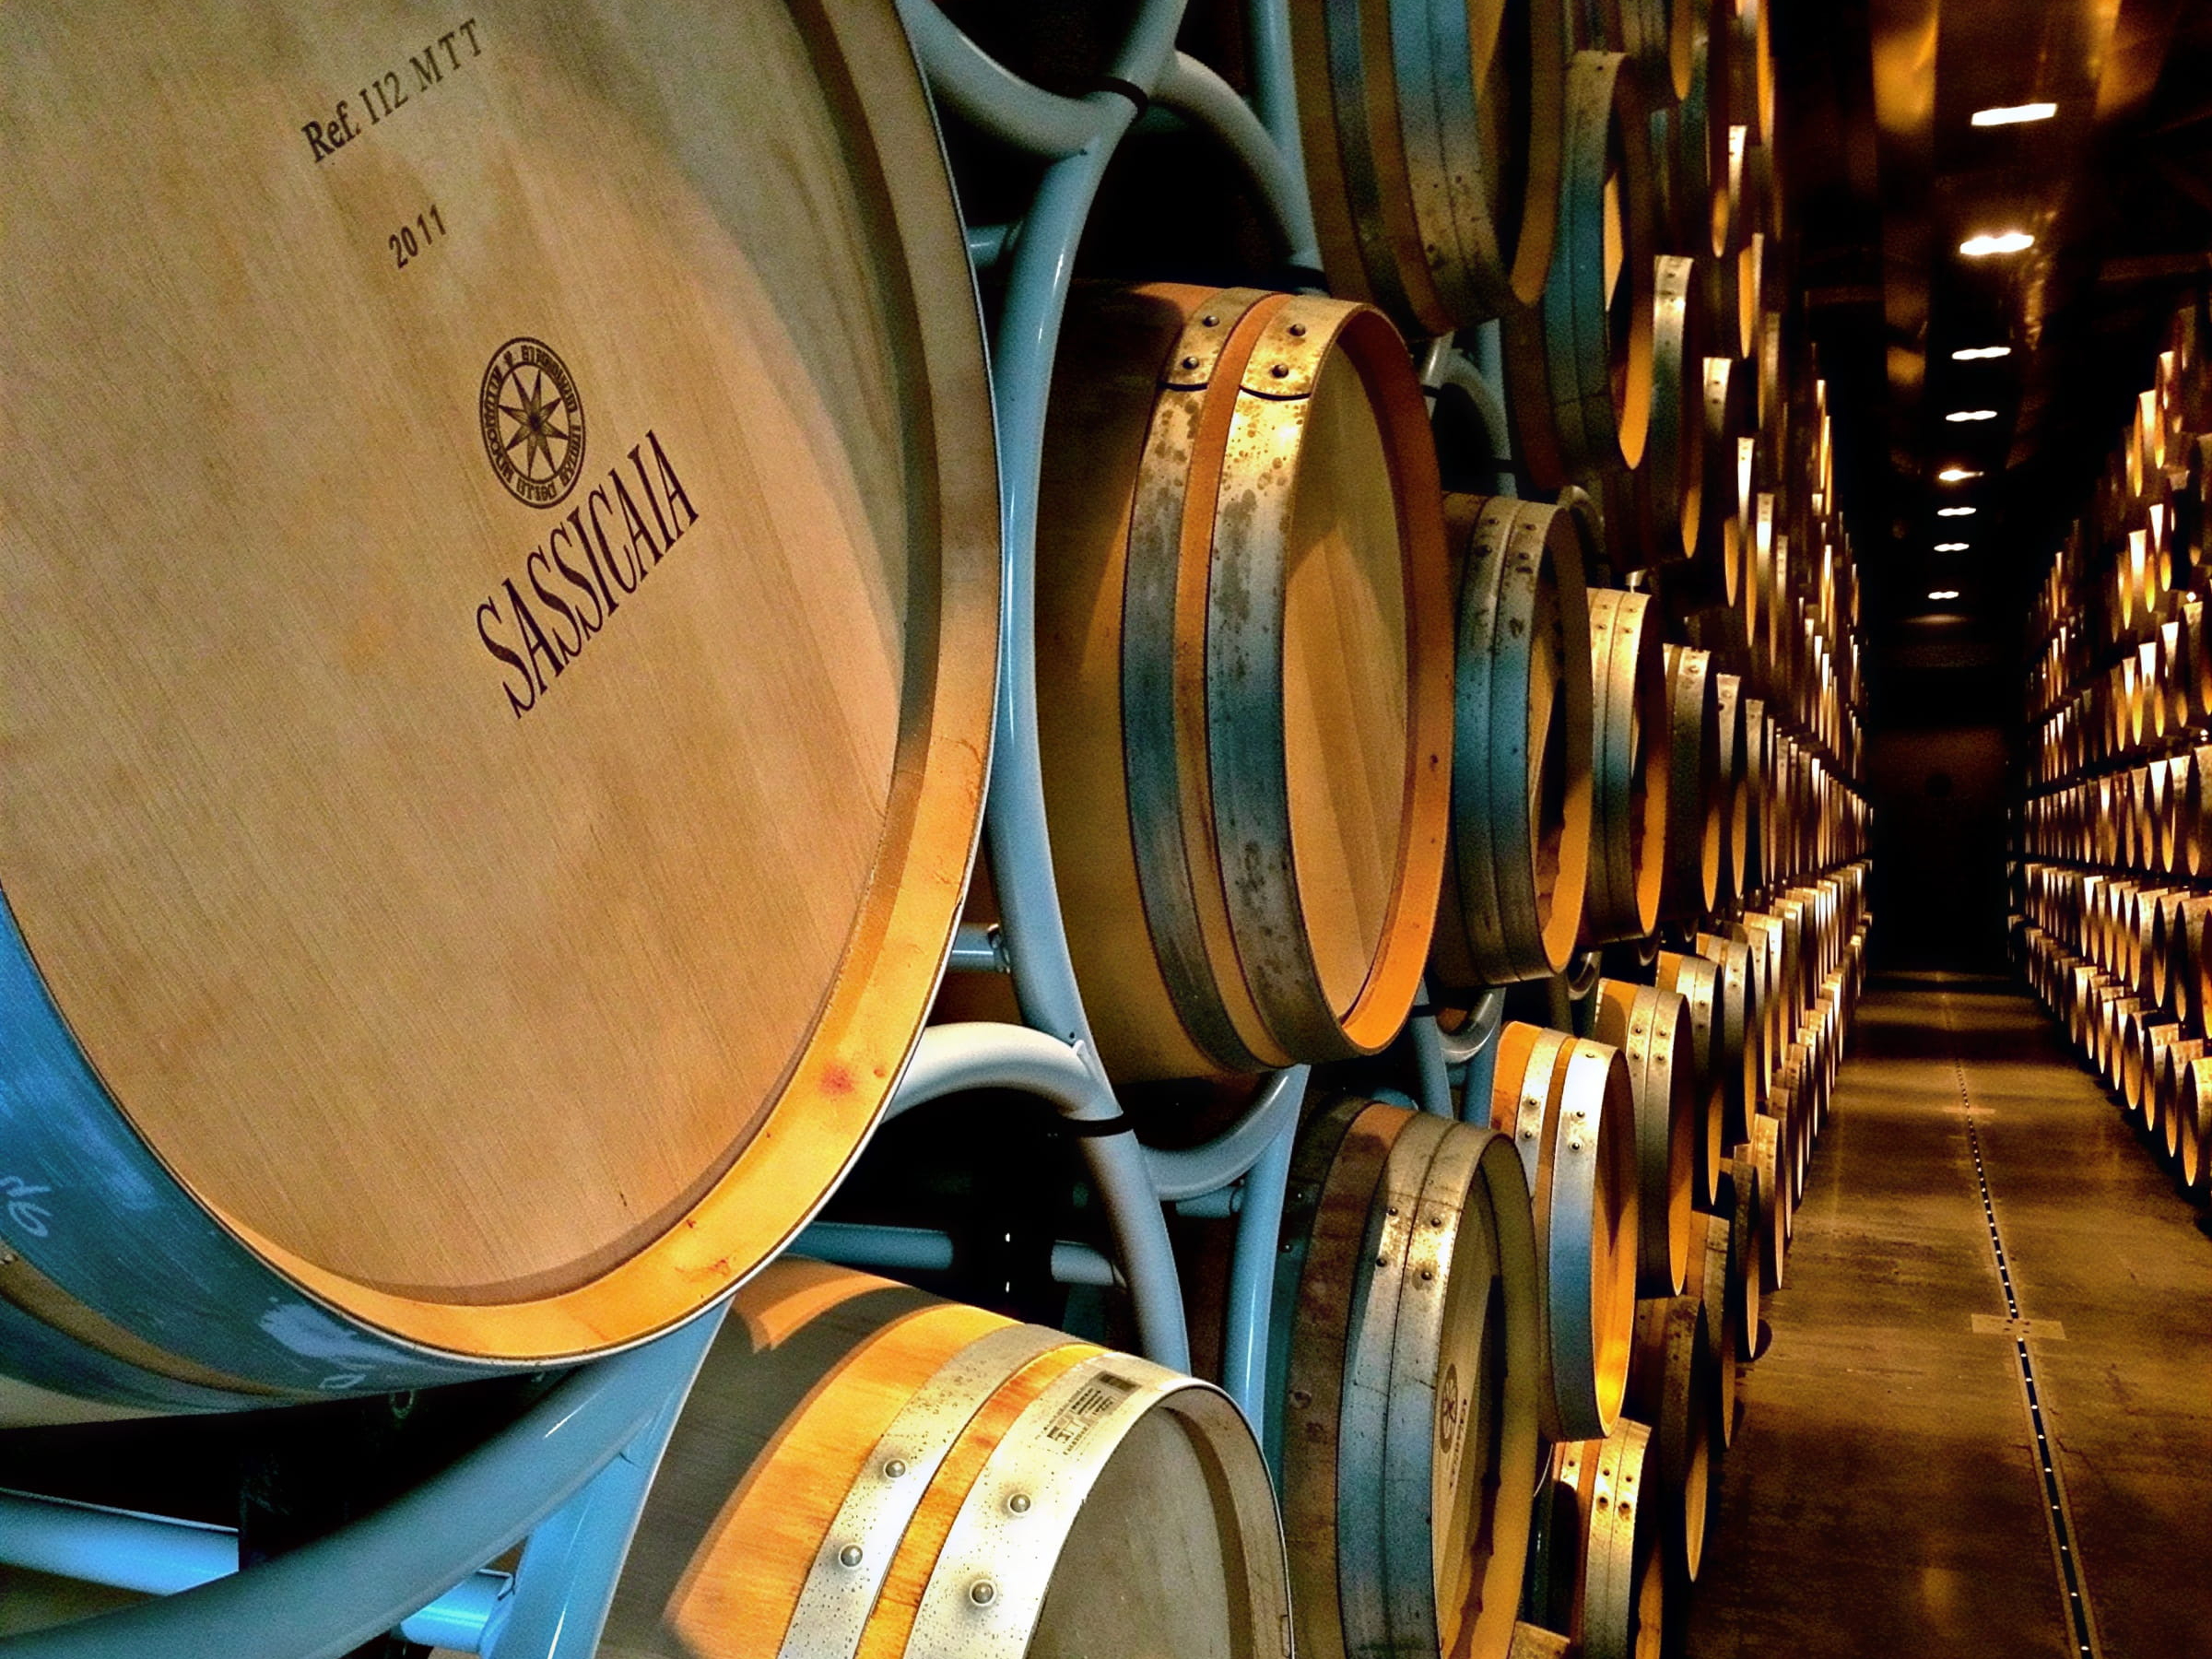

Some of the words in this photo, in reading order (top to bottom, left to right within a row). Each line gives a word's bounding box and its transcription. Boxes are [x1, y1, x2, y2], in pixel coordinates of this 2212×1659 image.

[300, 100, 361, 163] Ref.
[389, 205, 447, 269] 2011
[477, 429, 699, 720] SASSICAIA
